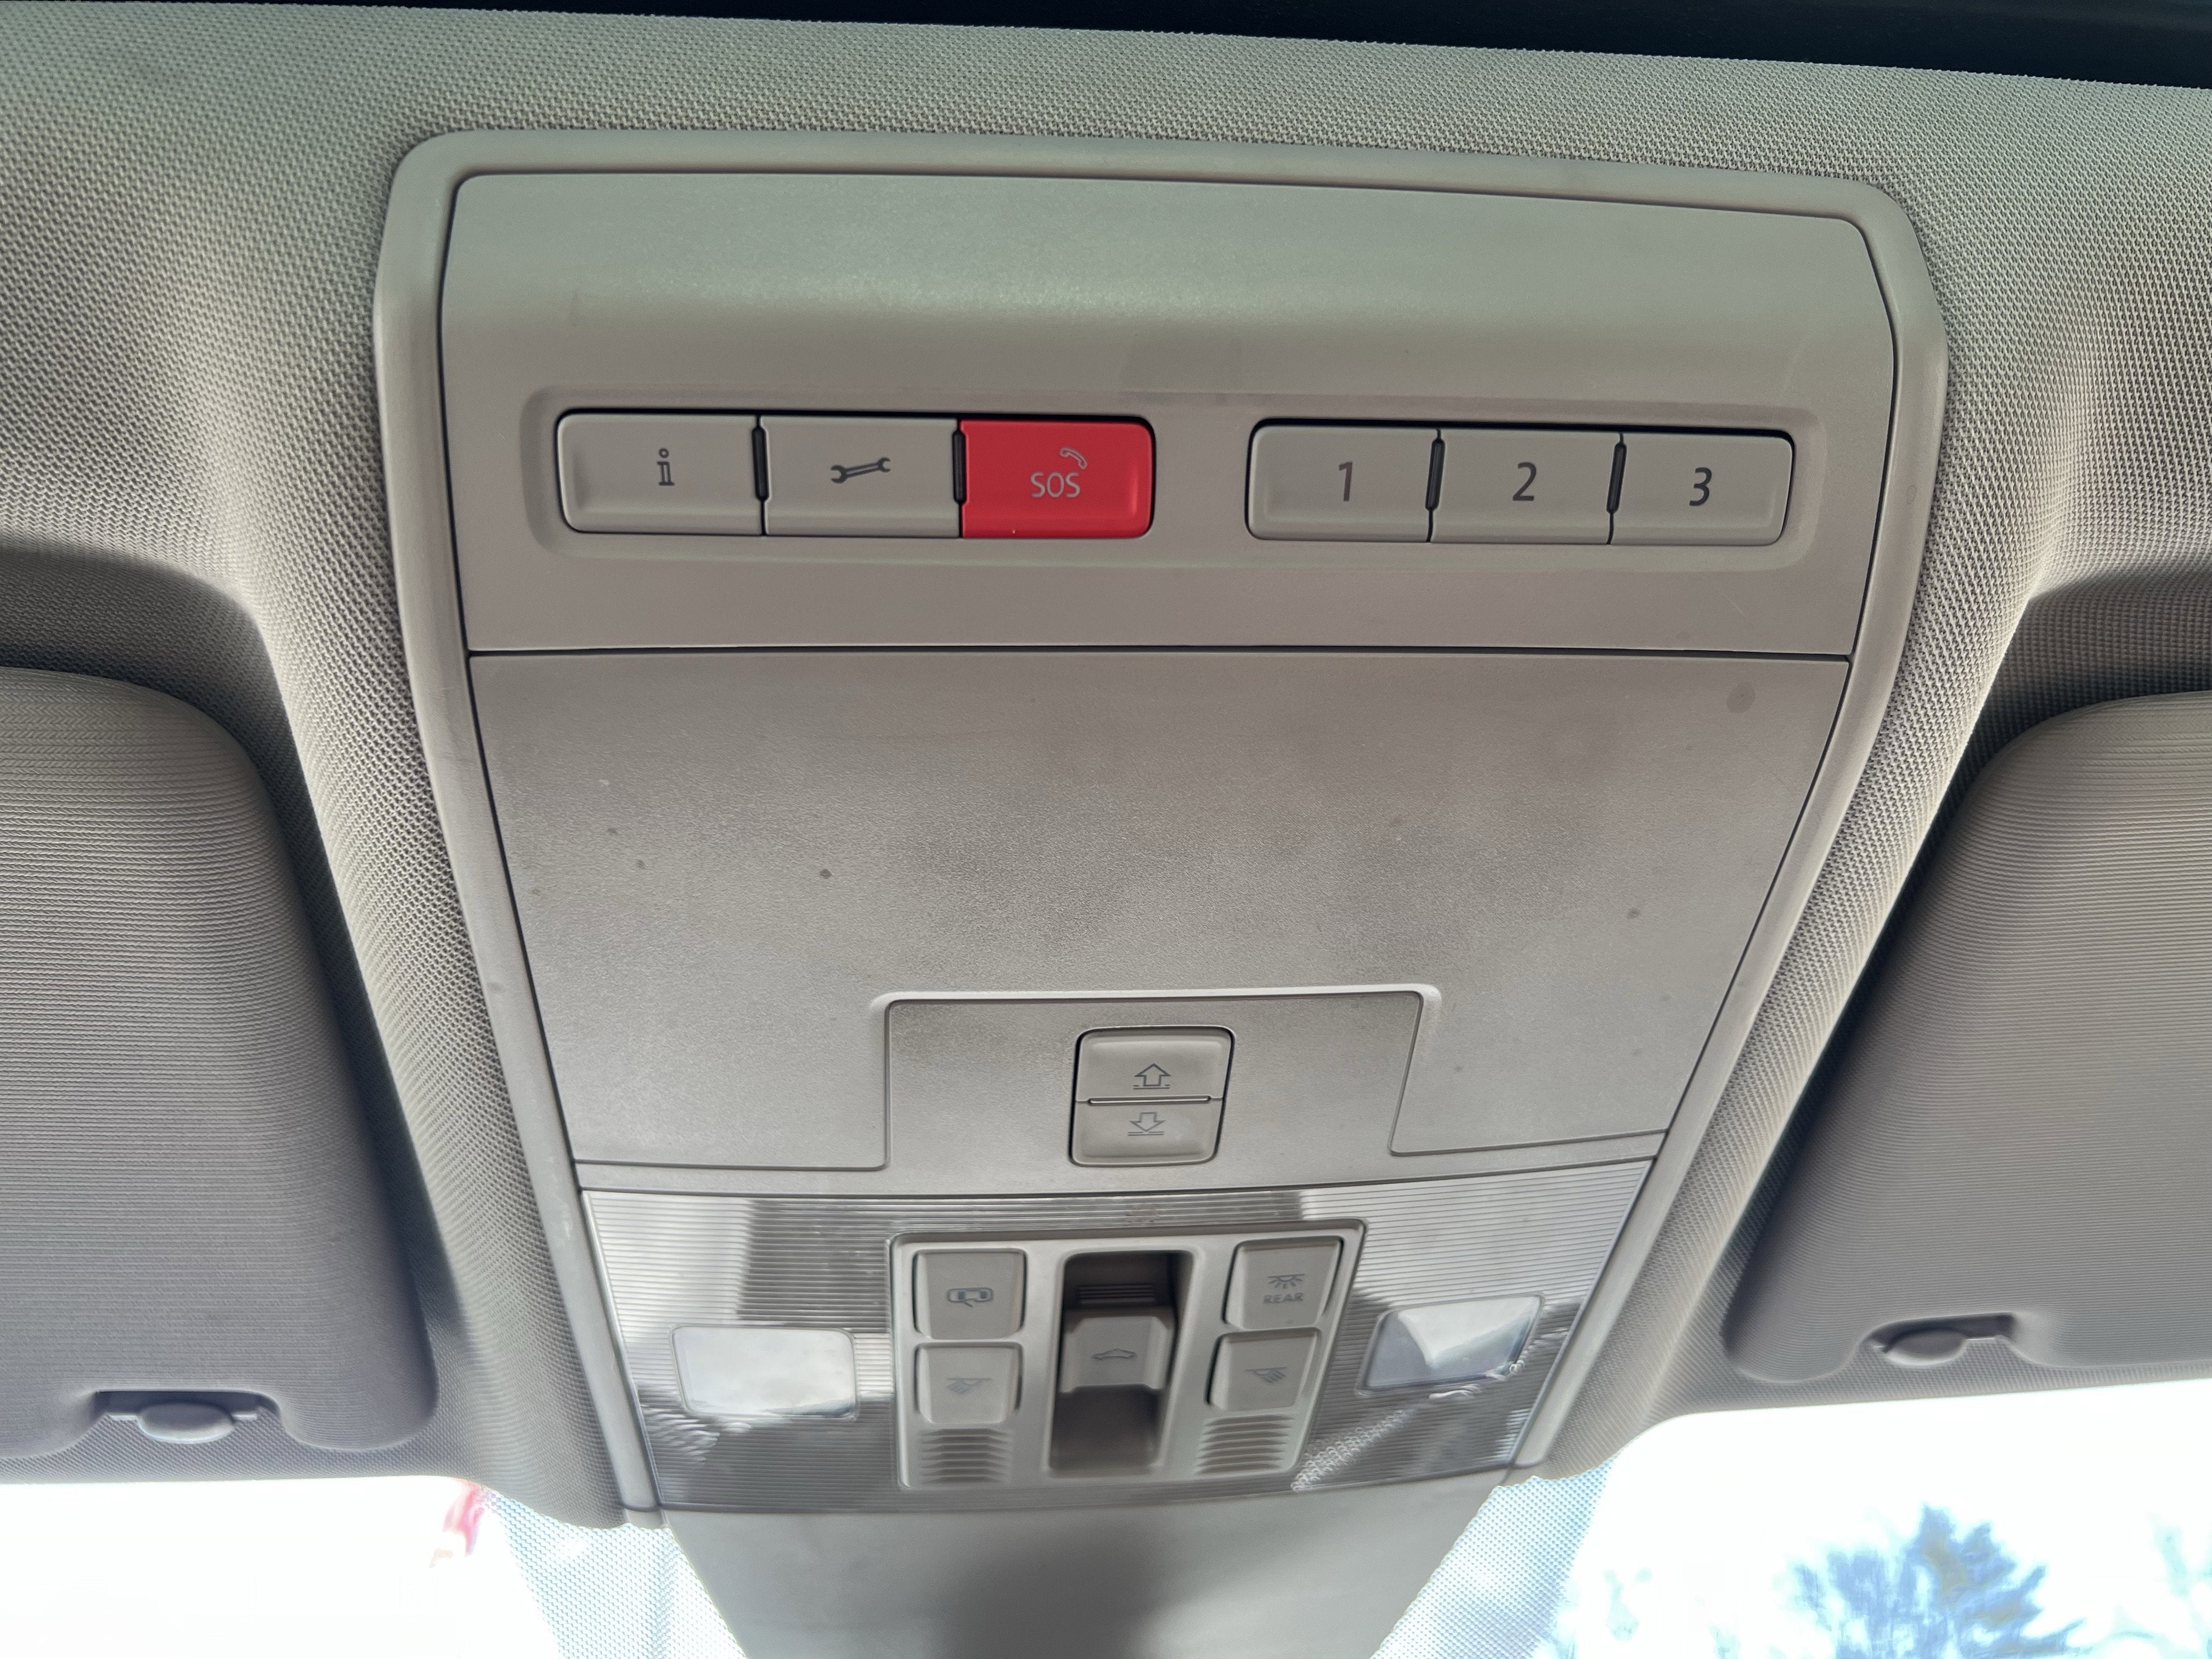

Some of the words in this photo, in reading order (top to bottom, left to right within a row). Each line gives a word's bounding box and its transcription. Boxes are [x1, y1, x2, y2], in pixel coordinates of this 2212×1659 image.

[1030, 472, 1081, 498] SOS
[1338, 462, 1353, 502] 1
[1511, 462, 1537, 502] 2
[1689, 467, 1712, 507] 3
[1263, 1291, 1304, 1305] REAR
